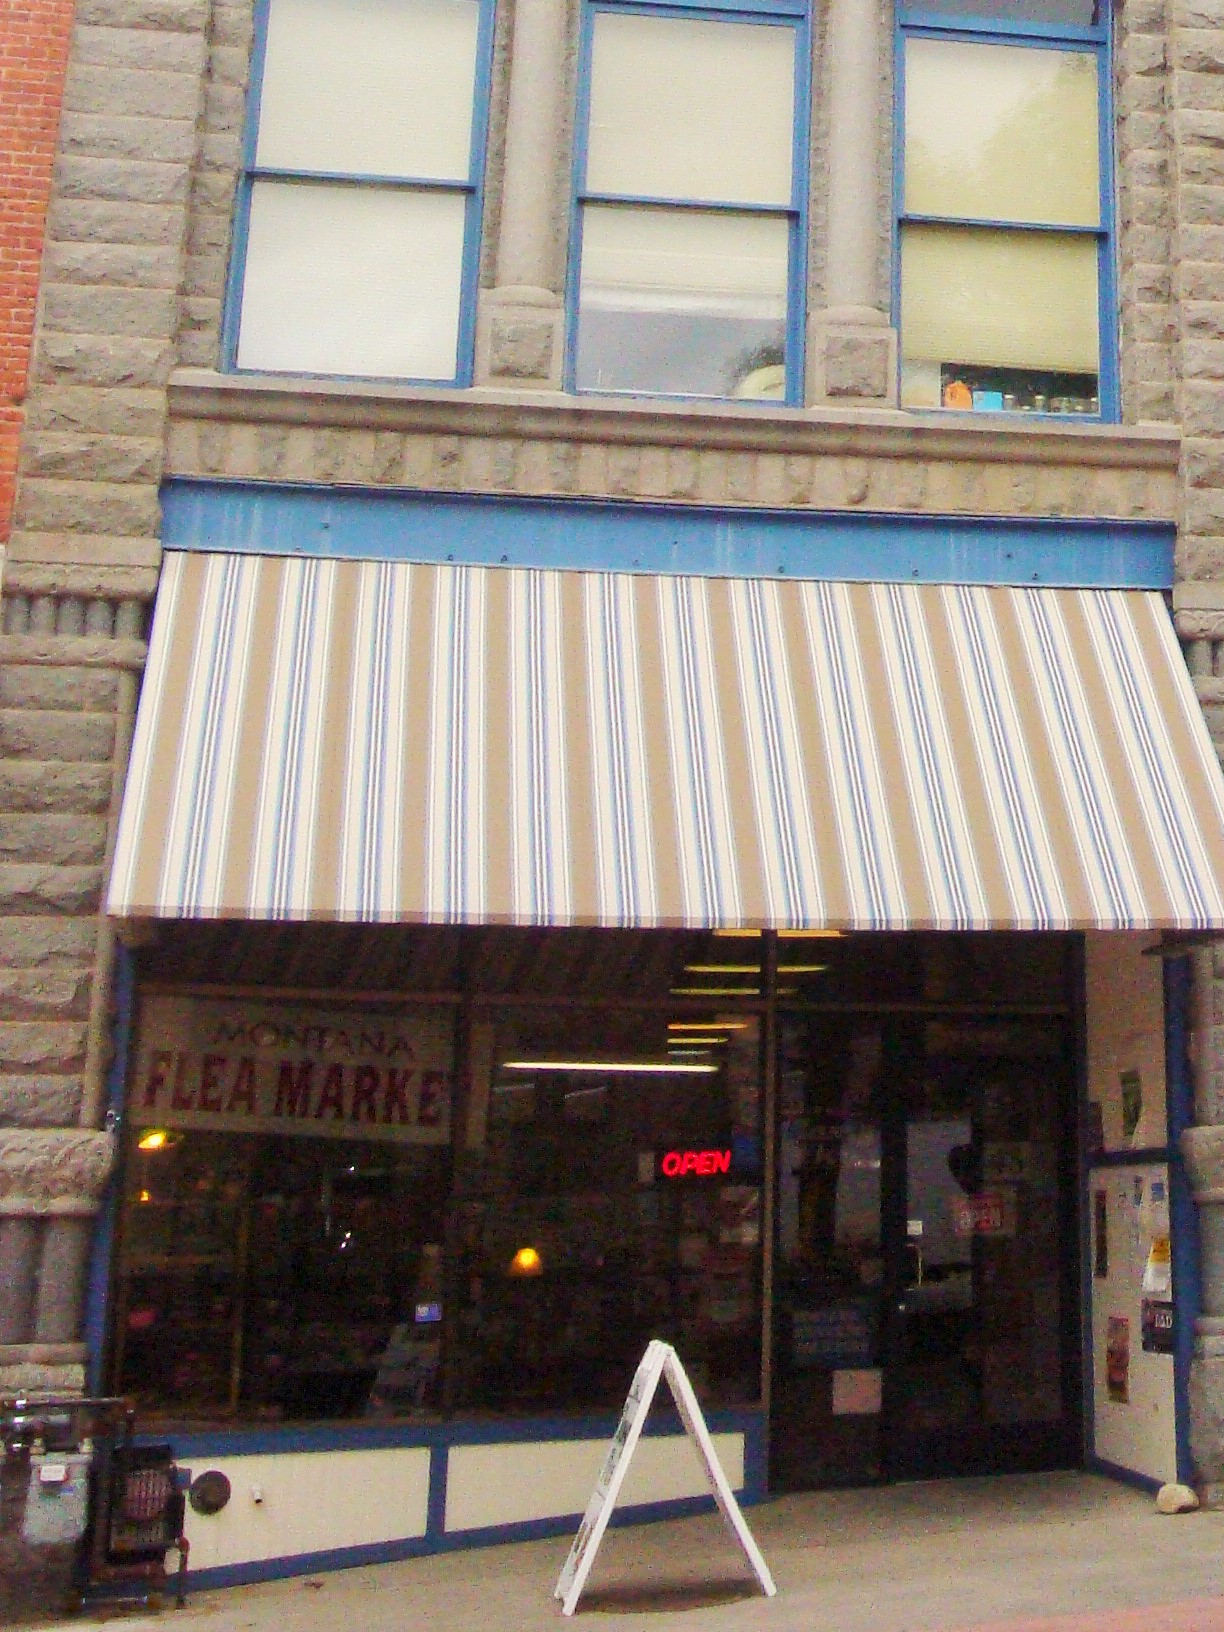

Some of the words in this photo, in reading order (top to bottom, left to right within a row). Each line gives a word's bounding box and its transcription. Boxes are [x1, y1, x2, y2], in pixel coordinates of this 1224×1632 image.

[213, 1020, 415, 1060] MONTANA
[143, 1050, 258, 1113] FLEA
[274, 1058, 450, 1126] MARKE
[662, 1149, 731, 1177] OPEN
